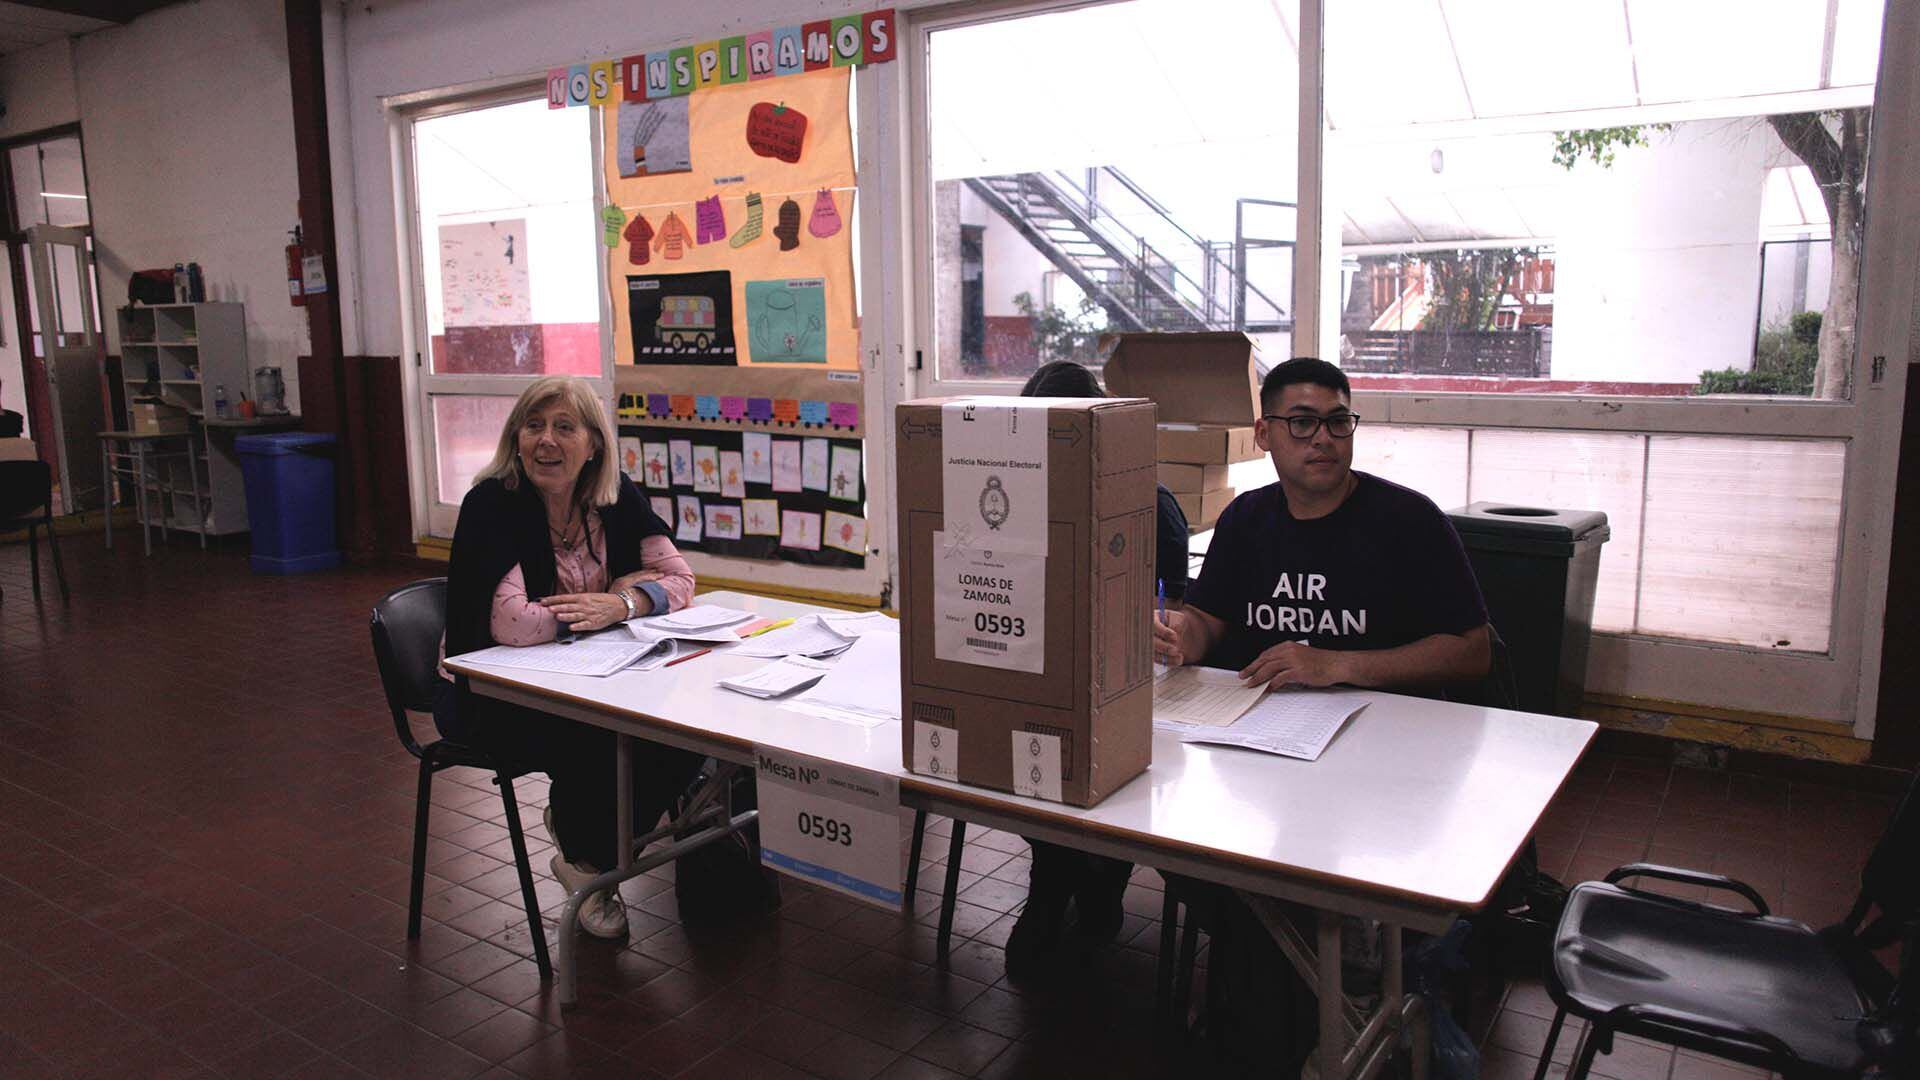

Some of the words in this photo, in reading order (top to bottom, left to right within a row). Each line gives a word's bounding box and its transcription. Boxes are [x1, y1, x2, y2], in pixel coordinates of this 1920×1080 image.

[550, 68, 609, 105] NOS
[629, 19, 889, 93] INSPIRAMOS
[948, 457, 975, 466] Justicia
[976, 458, 1008, 468] Nacional
[1009, 460, 1042, 470] Electoral
[958, 573, 997, 589] LOMAS
[999, 579, 1014, 591] DE
[1271, 572, 1327, 600] AIR
[963, 589, 1011, 605] ZAMORA
[974, 612, 1026, 637] 0593
[1246, 602, 1366, 636] JORDAN
[758, 755, 796, 780] Mesa
[798, 812, 852, 846] 0593
